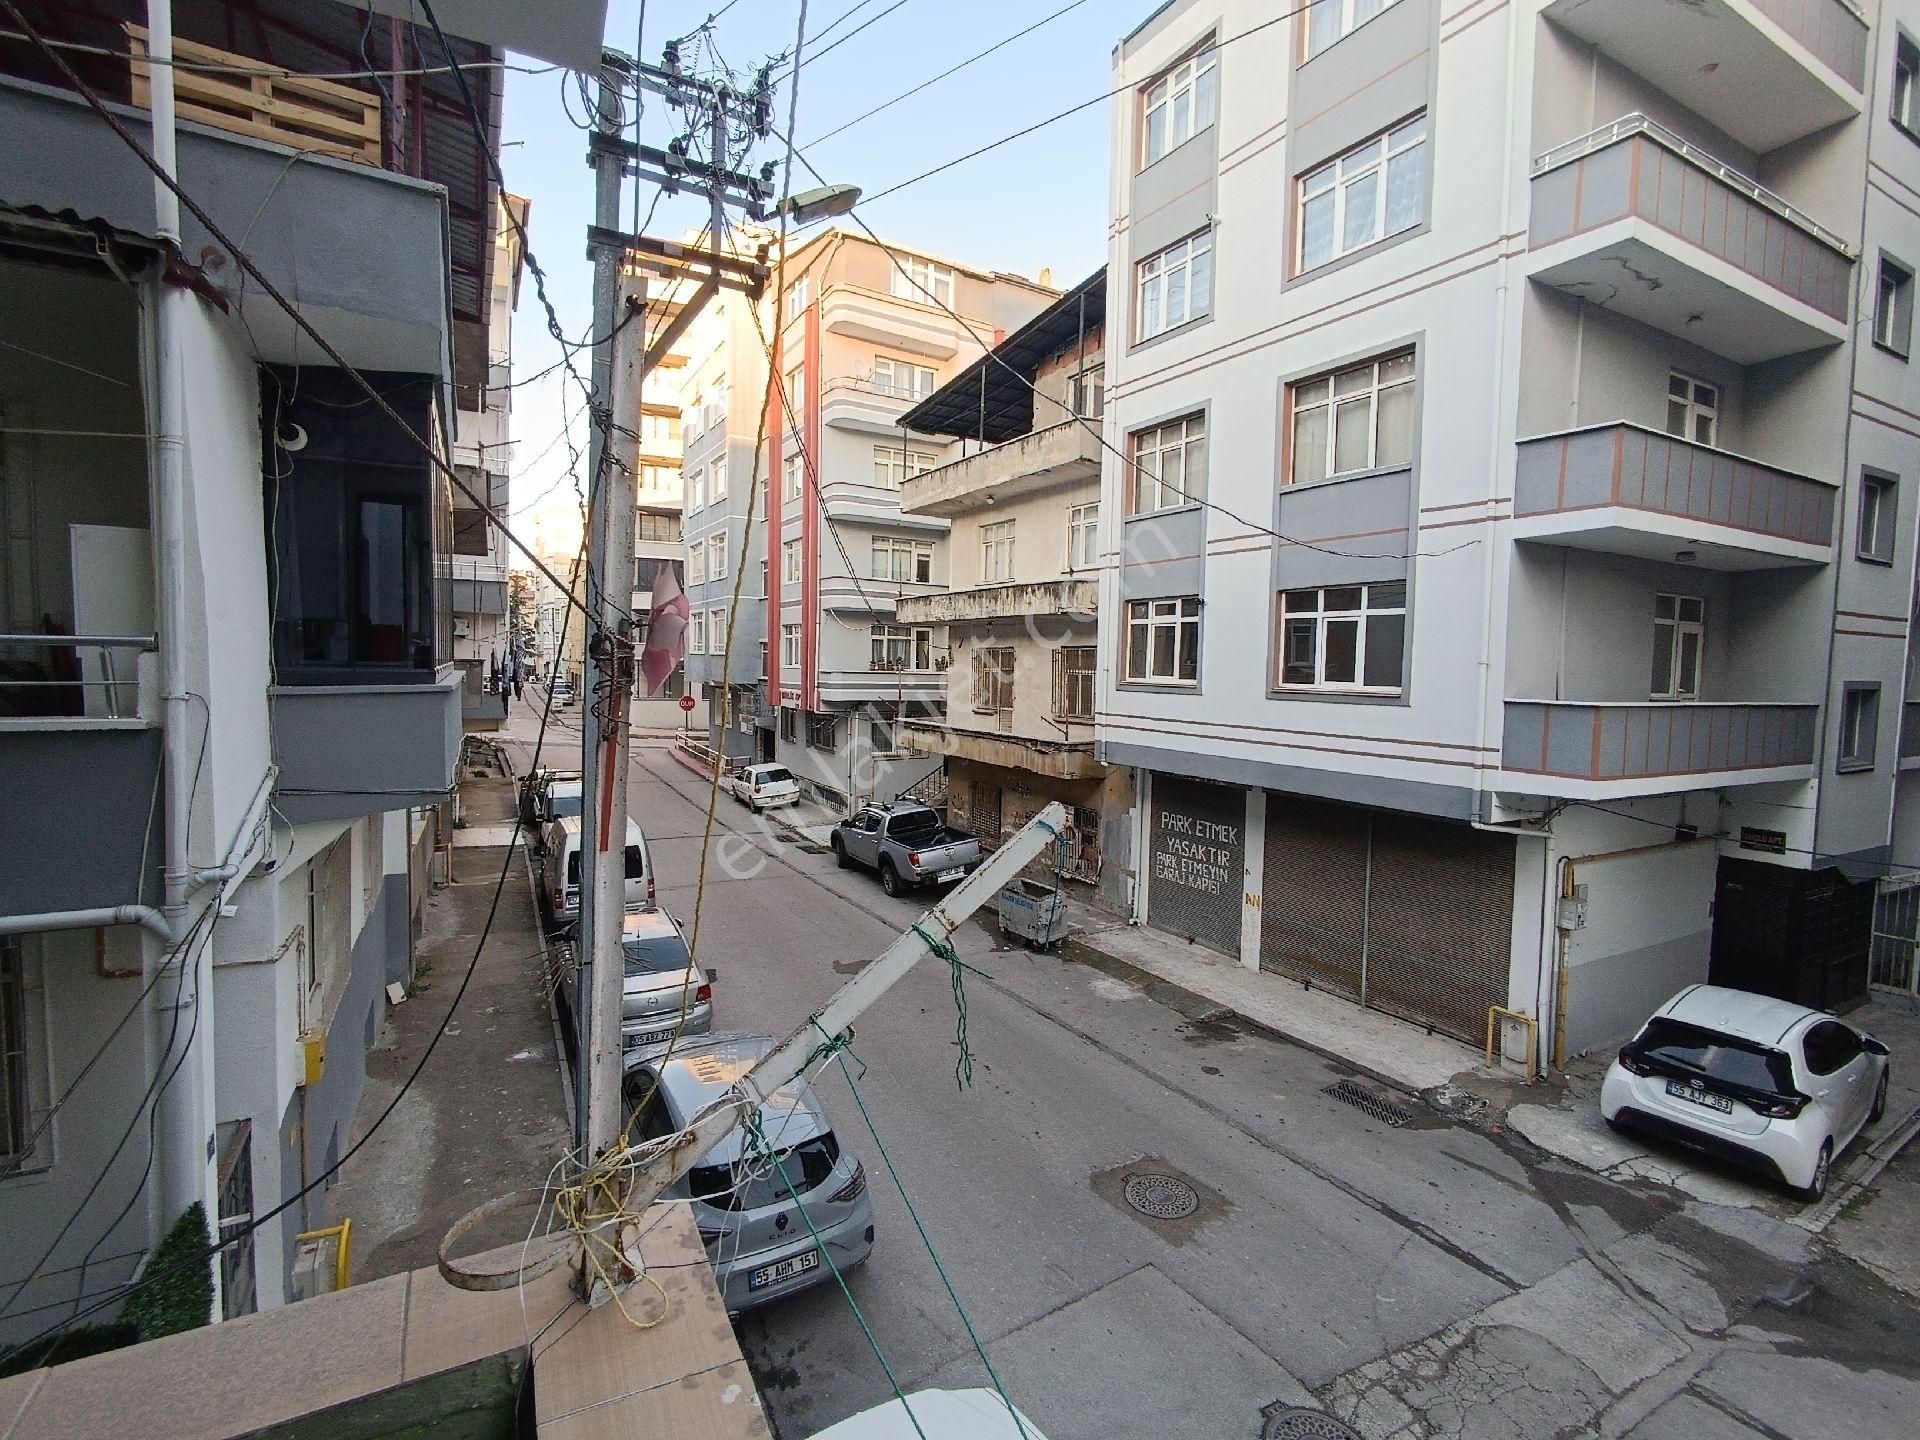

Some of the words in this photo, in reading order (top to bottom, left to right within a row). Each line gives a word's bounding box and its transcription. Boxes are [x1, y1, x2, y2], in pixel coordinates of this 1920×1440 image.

[681, 699, 694, 707] DUR
[1161, 811, 1192, 835] PARK
[1196, 820, 1237, 845] ETMEK
[1156, 851, 1177, 868] PARK
[1166, 836, 1230, 867] YASAKTIR
[1156, 865, 1184, 884] GARAJ
[1673, 1083, 1685, 1096] 55
[1689, 1089, 1706, 1102] AJY
[1711, 1095, 1729, 1109] 363
[768, 1228, 796, 1240] CLIO
[756, 1268, 769, 1284] 55
[775, 1260, 794, 1278] AHM
[799, 1252, 816, 1269] 151
